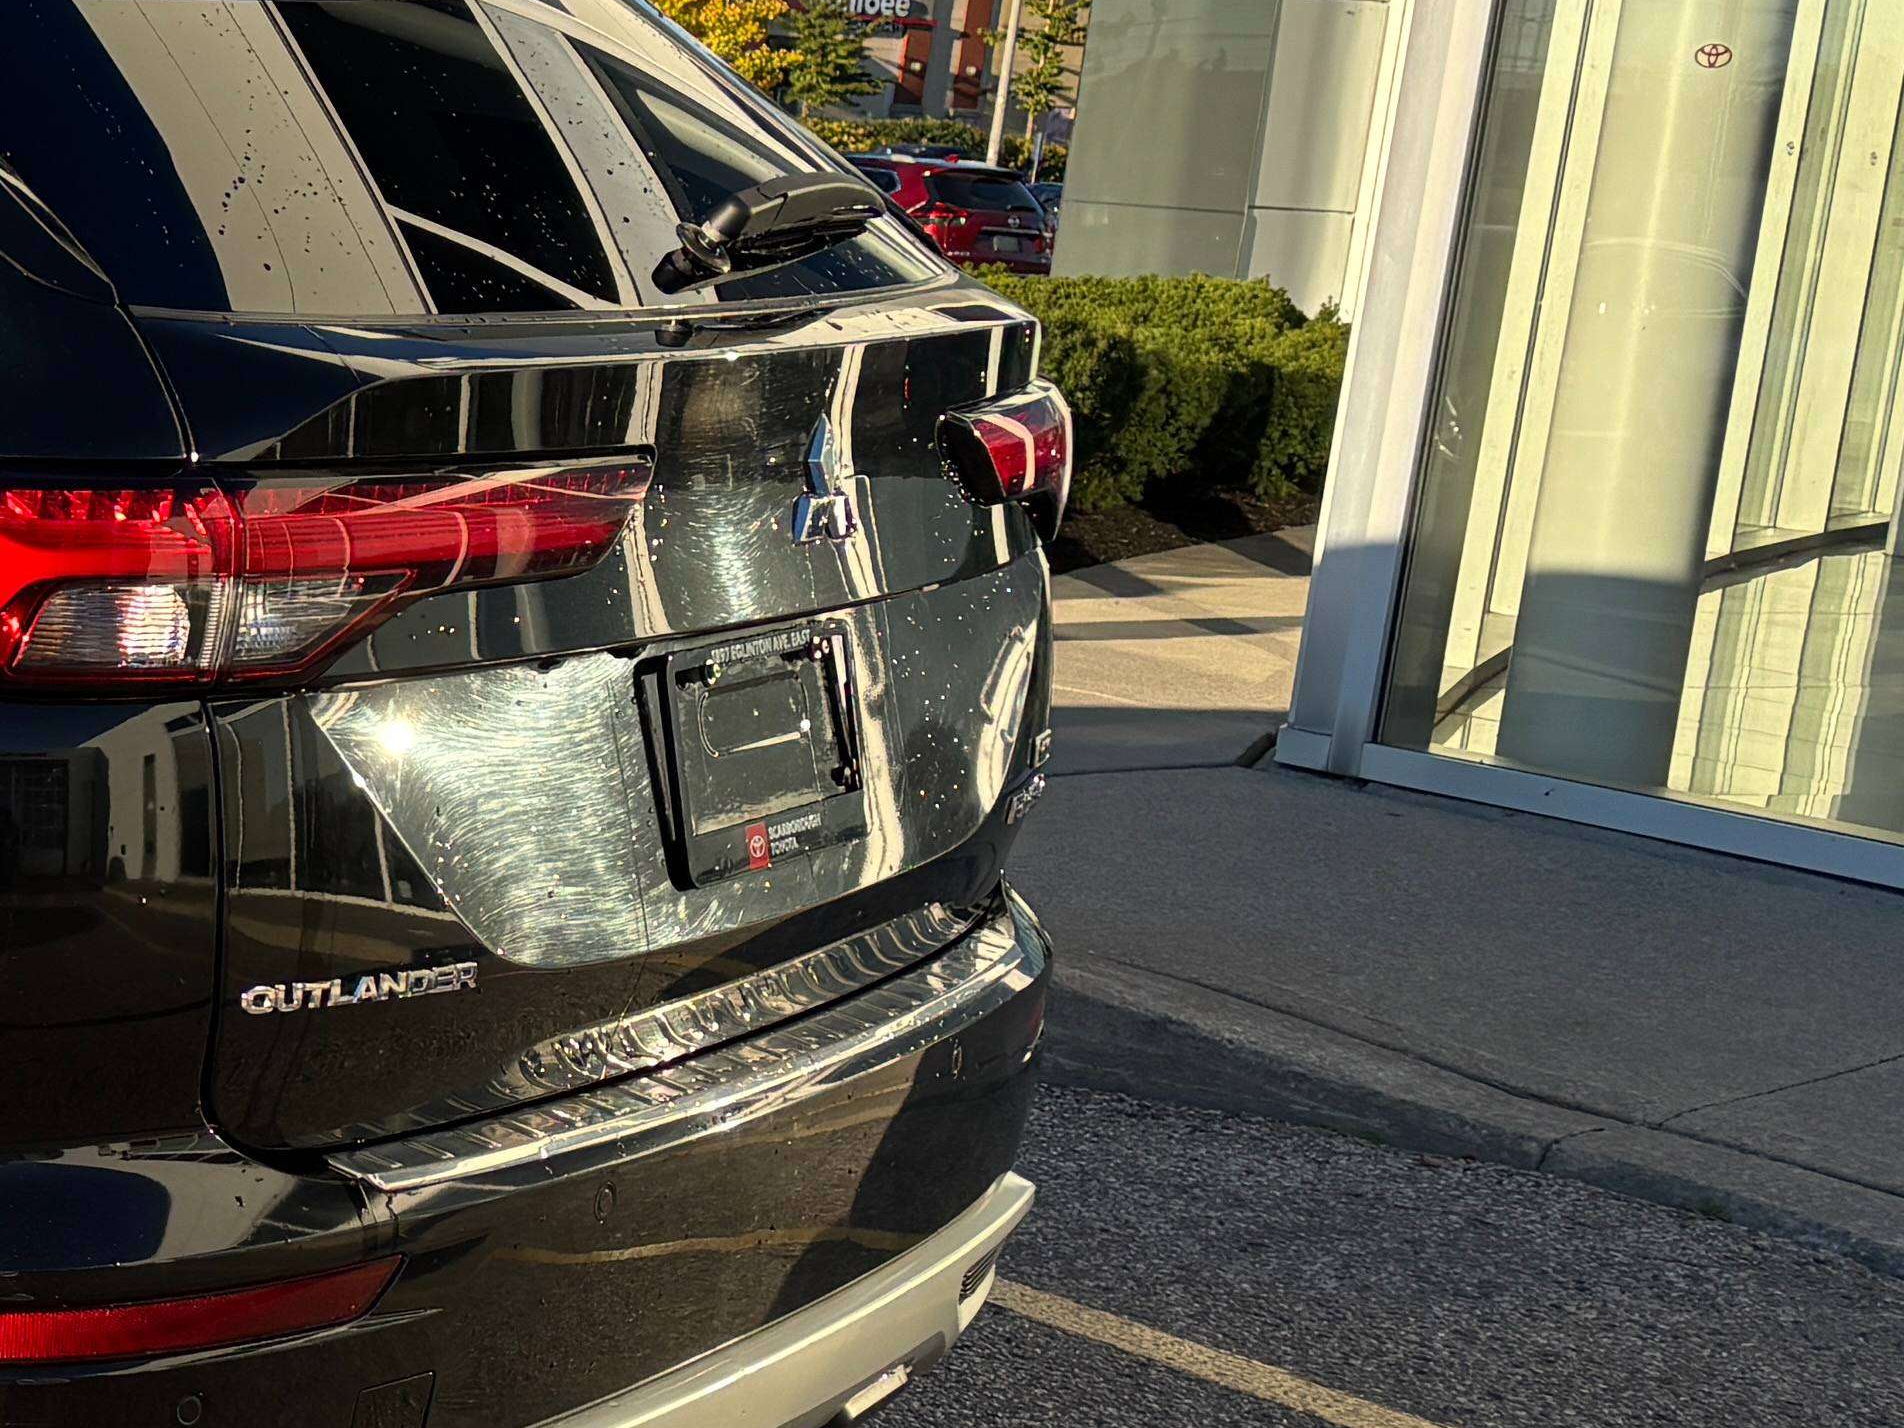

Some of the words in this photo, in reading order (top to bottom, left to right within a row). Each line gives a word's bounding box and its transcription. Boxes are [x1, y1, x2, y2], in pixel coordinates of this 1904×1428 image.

[731, 635, 773, 661] EGLINTON
[792, 628, 810, 649] EAST
[241, 961, 478, 1014] OUTLANDER
